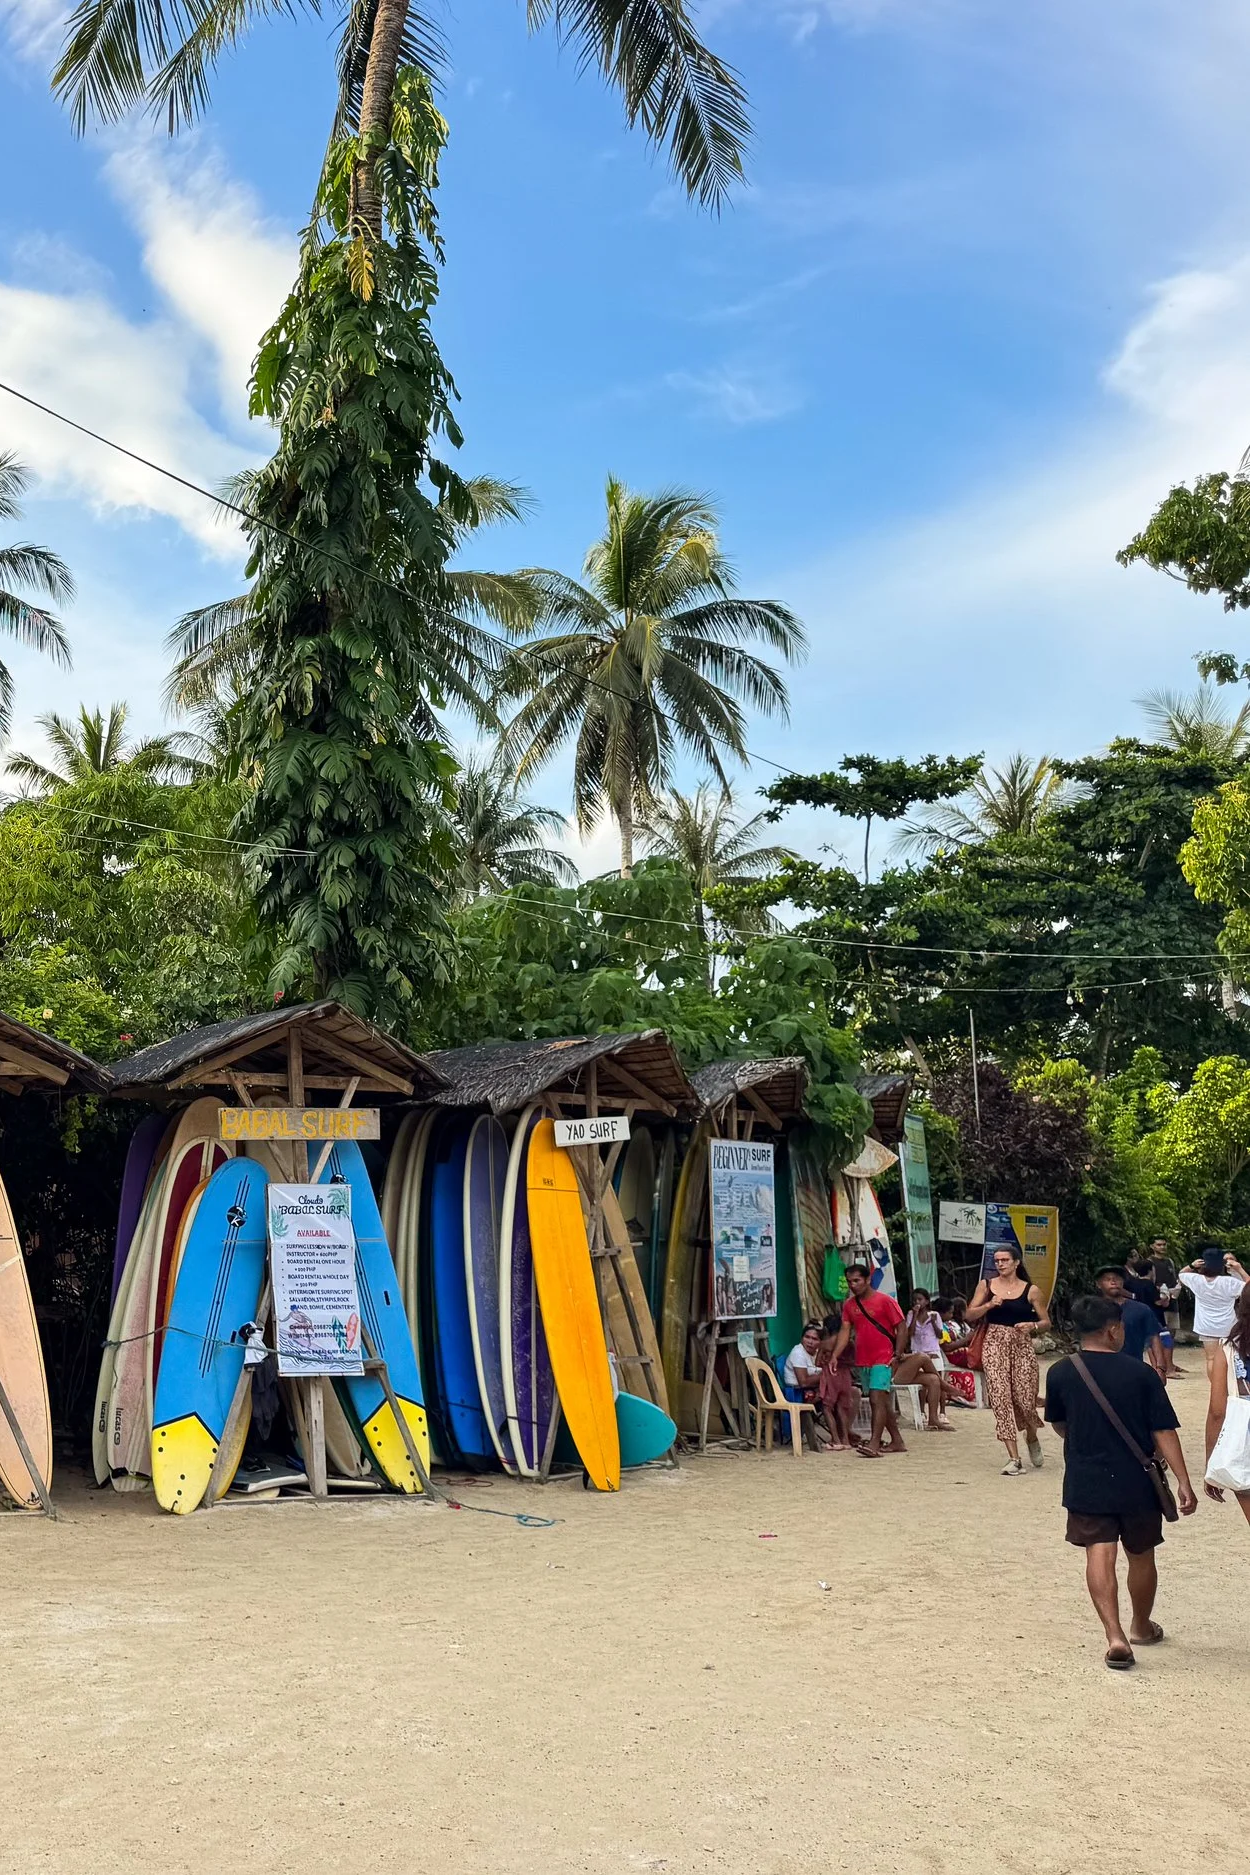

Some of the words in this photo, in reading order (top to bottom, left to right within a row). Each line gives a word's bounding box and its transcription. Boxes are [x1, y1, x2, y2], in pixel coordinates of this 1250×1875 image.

[221, 1109, 296, 1139] BABAL
[302, 1110, 366, 1138] SURF
[590, 1120, 618, 1139] SURF
[751, 1148, 771, 1162] SURF
[279, 1205, 315, 1215] BABAL
[316, 1205, 345, 1215] SURF
[115, 1407, 124, 1431] lucas
